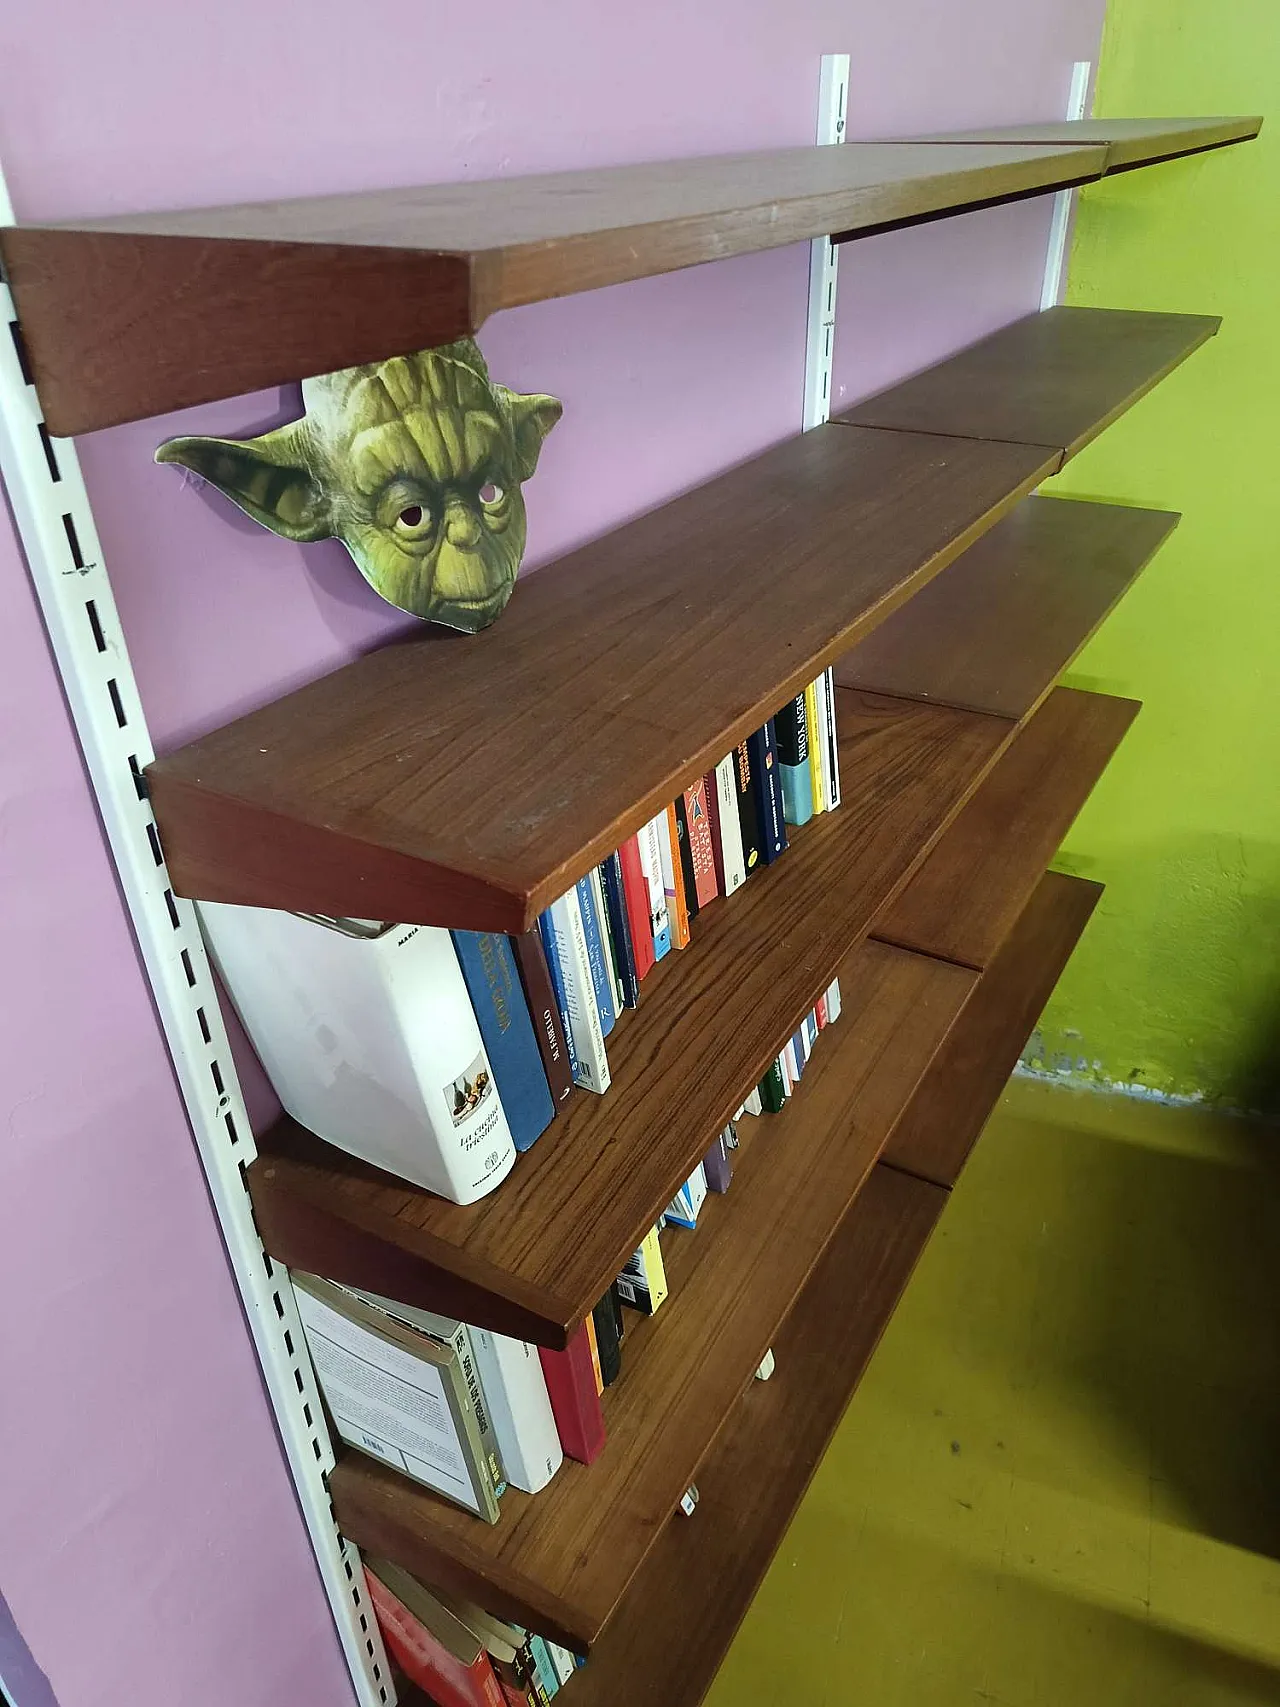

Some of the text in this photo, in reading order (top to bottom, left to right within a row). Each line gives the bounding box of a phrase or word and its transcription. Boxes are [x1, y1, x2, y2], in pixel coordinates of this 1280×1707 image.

[795, 693, 805, 724] NEW
[797, 725, 808, 761] YORK
[698, 822, 709, 875] BATISTA
[703, 821, 713, 868] TERESA
[397, 927, 419, 947] MARIA
[543, 1009, 559, 1052] FABELLO
[460, 1134, 472, 1147] La
[474, 1104, 498, 1136] cucina
[466, 1115, 499, 1151] triestina
